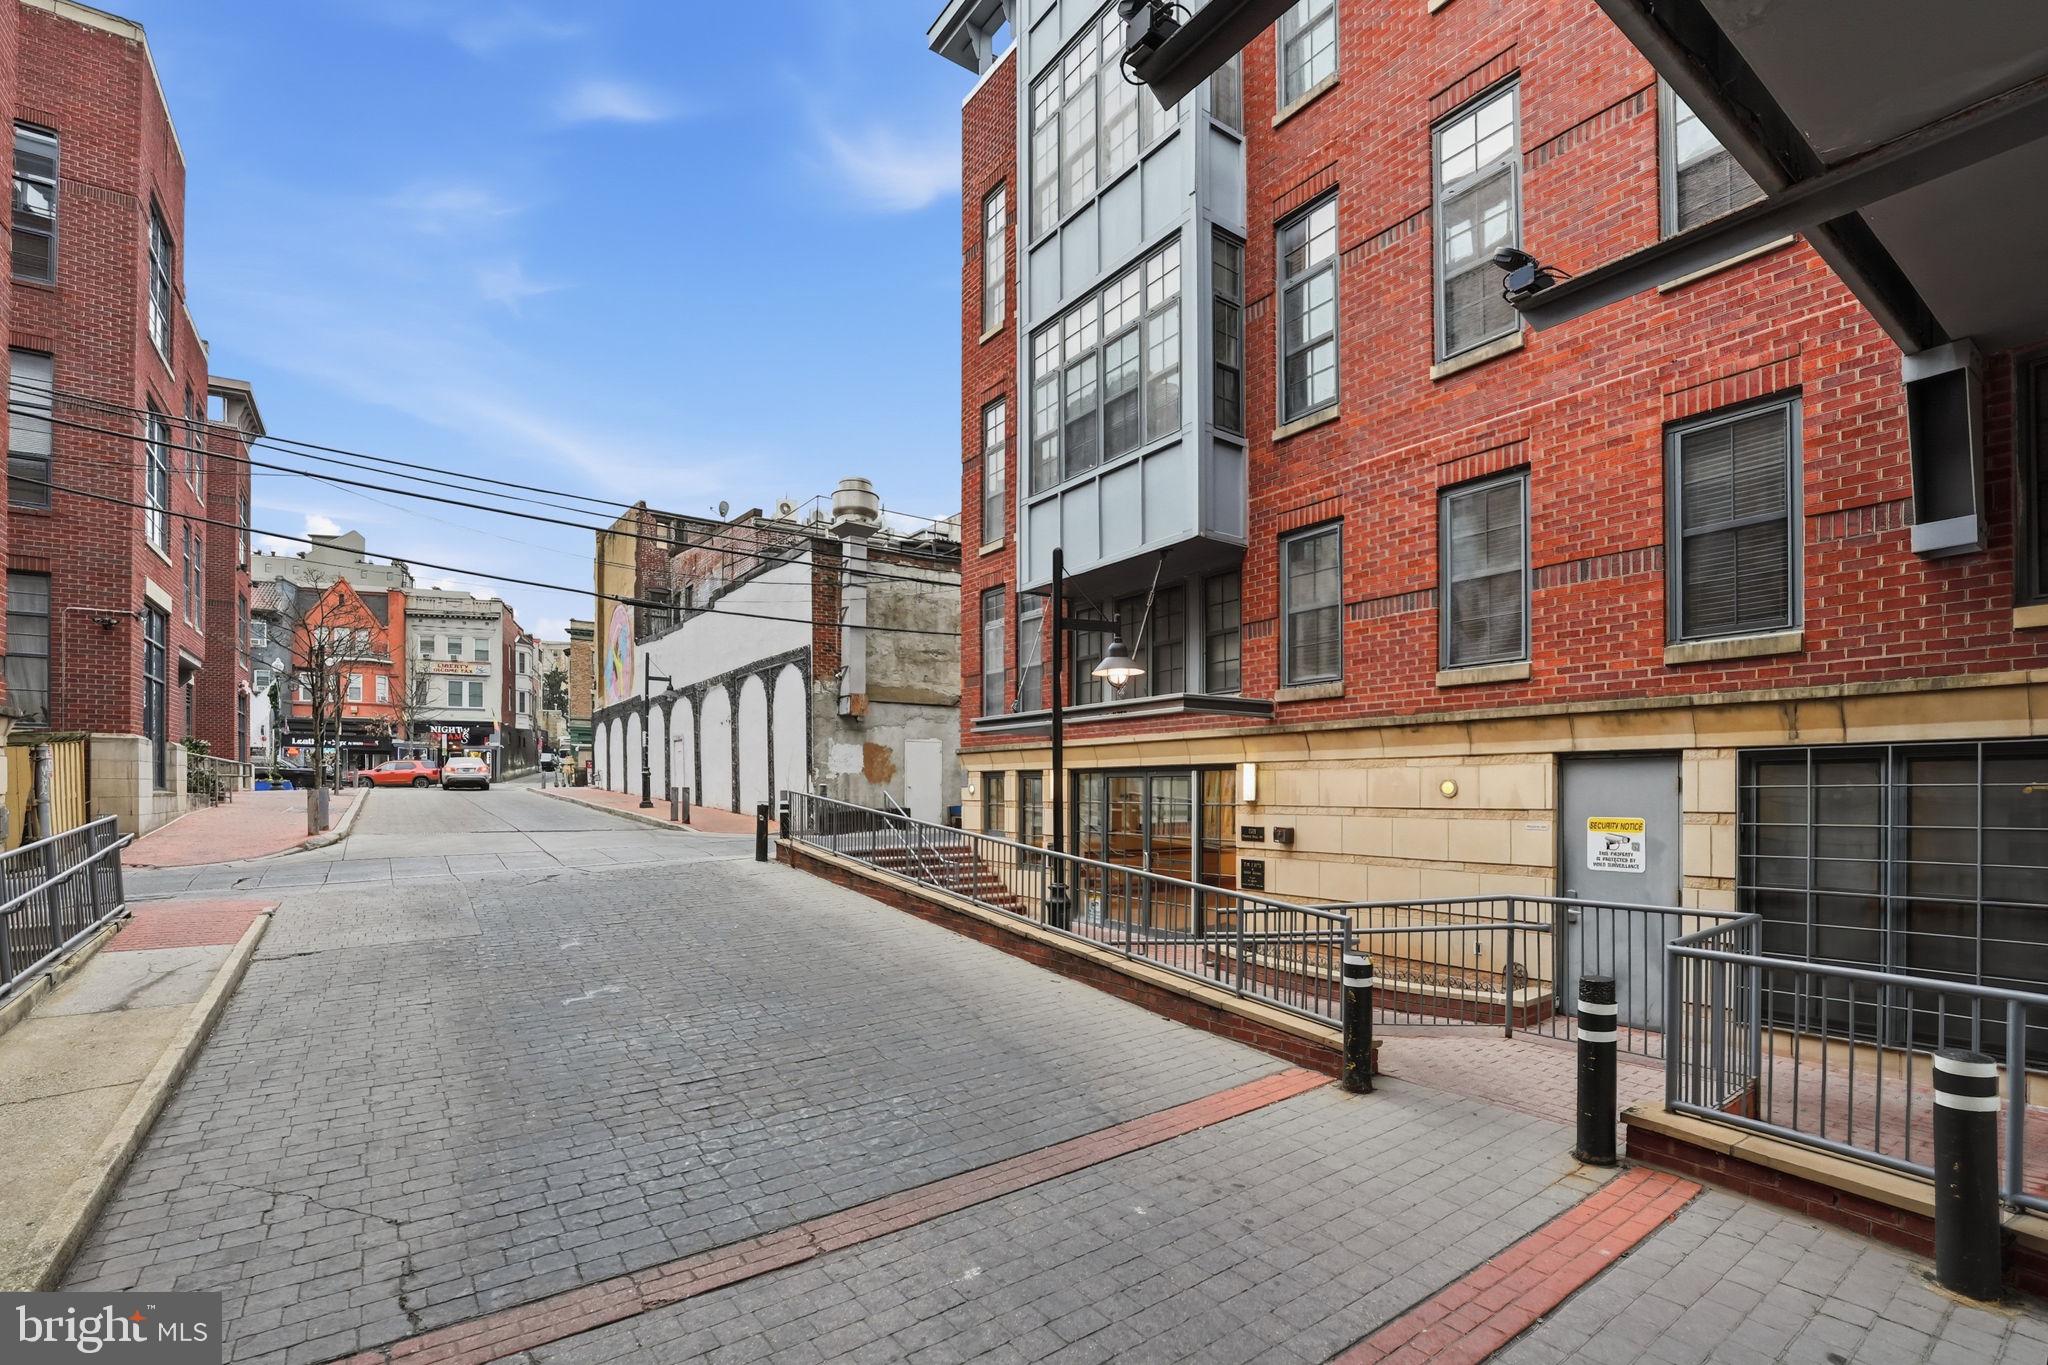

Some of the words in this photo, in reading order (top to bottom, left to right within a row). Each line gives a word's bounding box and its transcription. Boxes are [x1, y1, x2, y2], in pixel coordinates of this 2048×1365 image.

[430, 725, 463, 734] NIGHT
[1590, 822, 1619, 830] SECURITY
[1620, 822, 1643, 831] NOTICE
